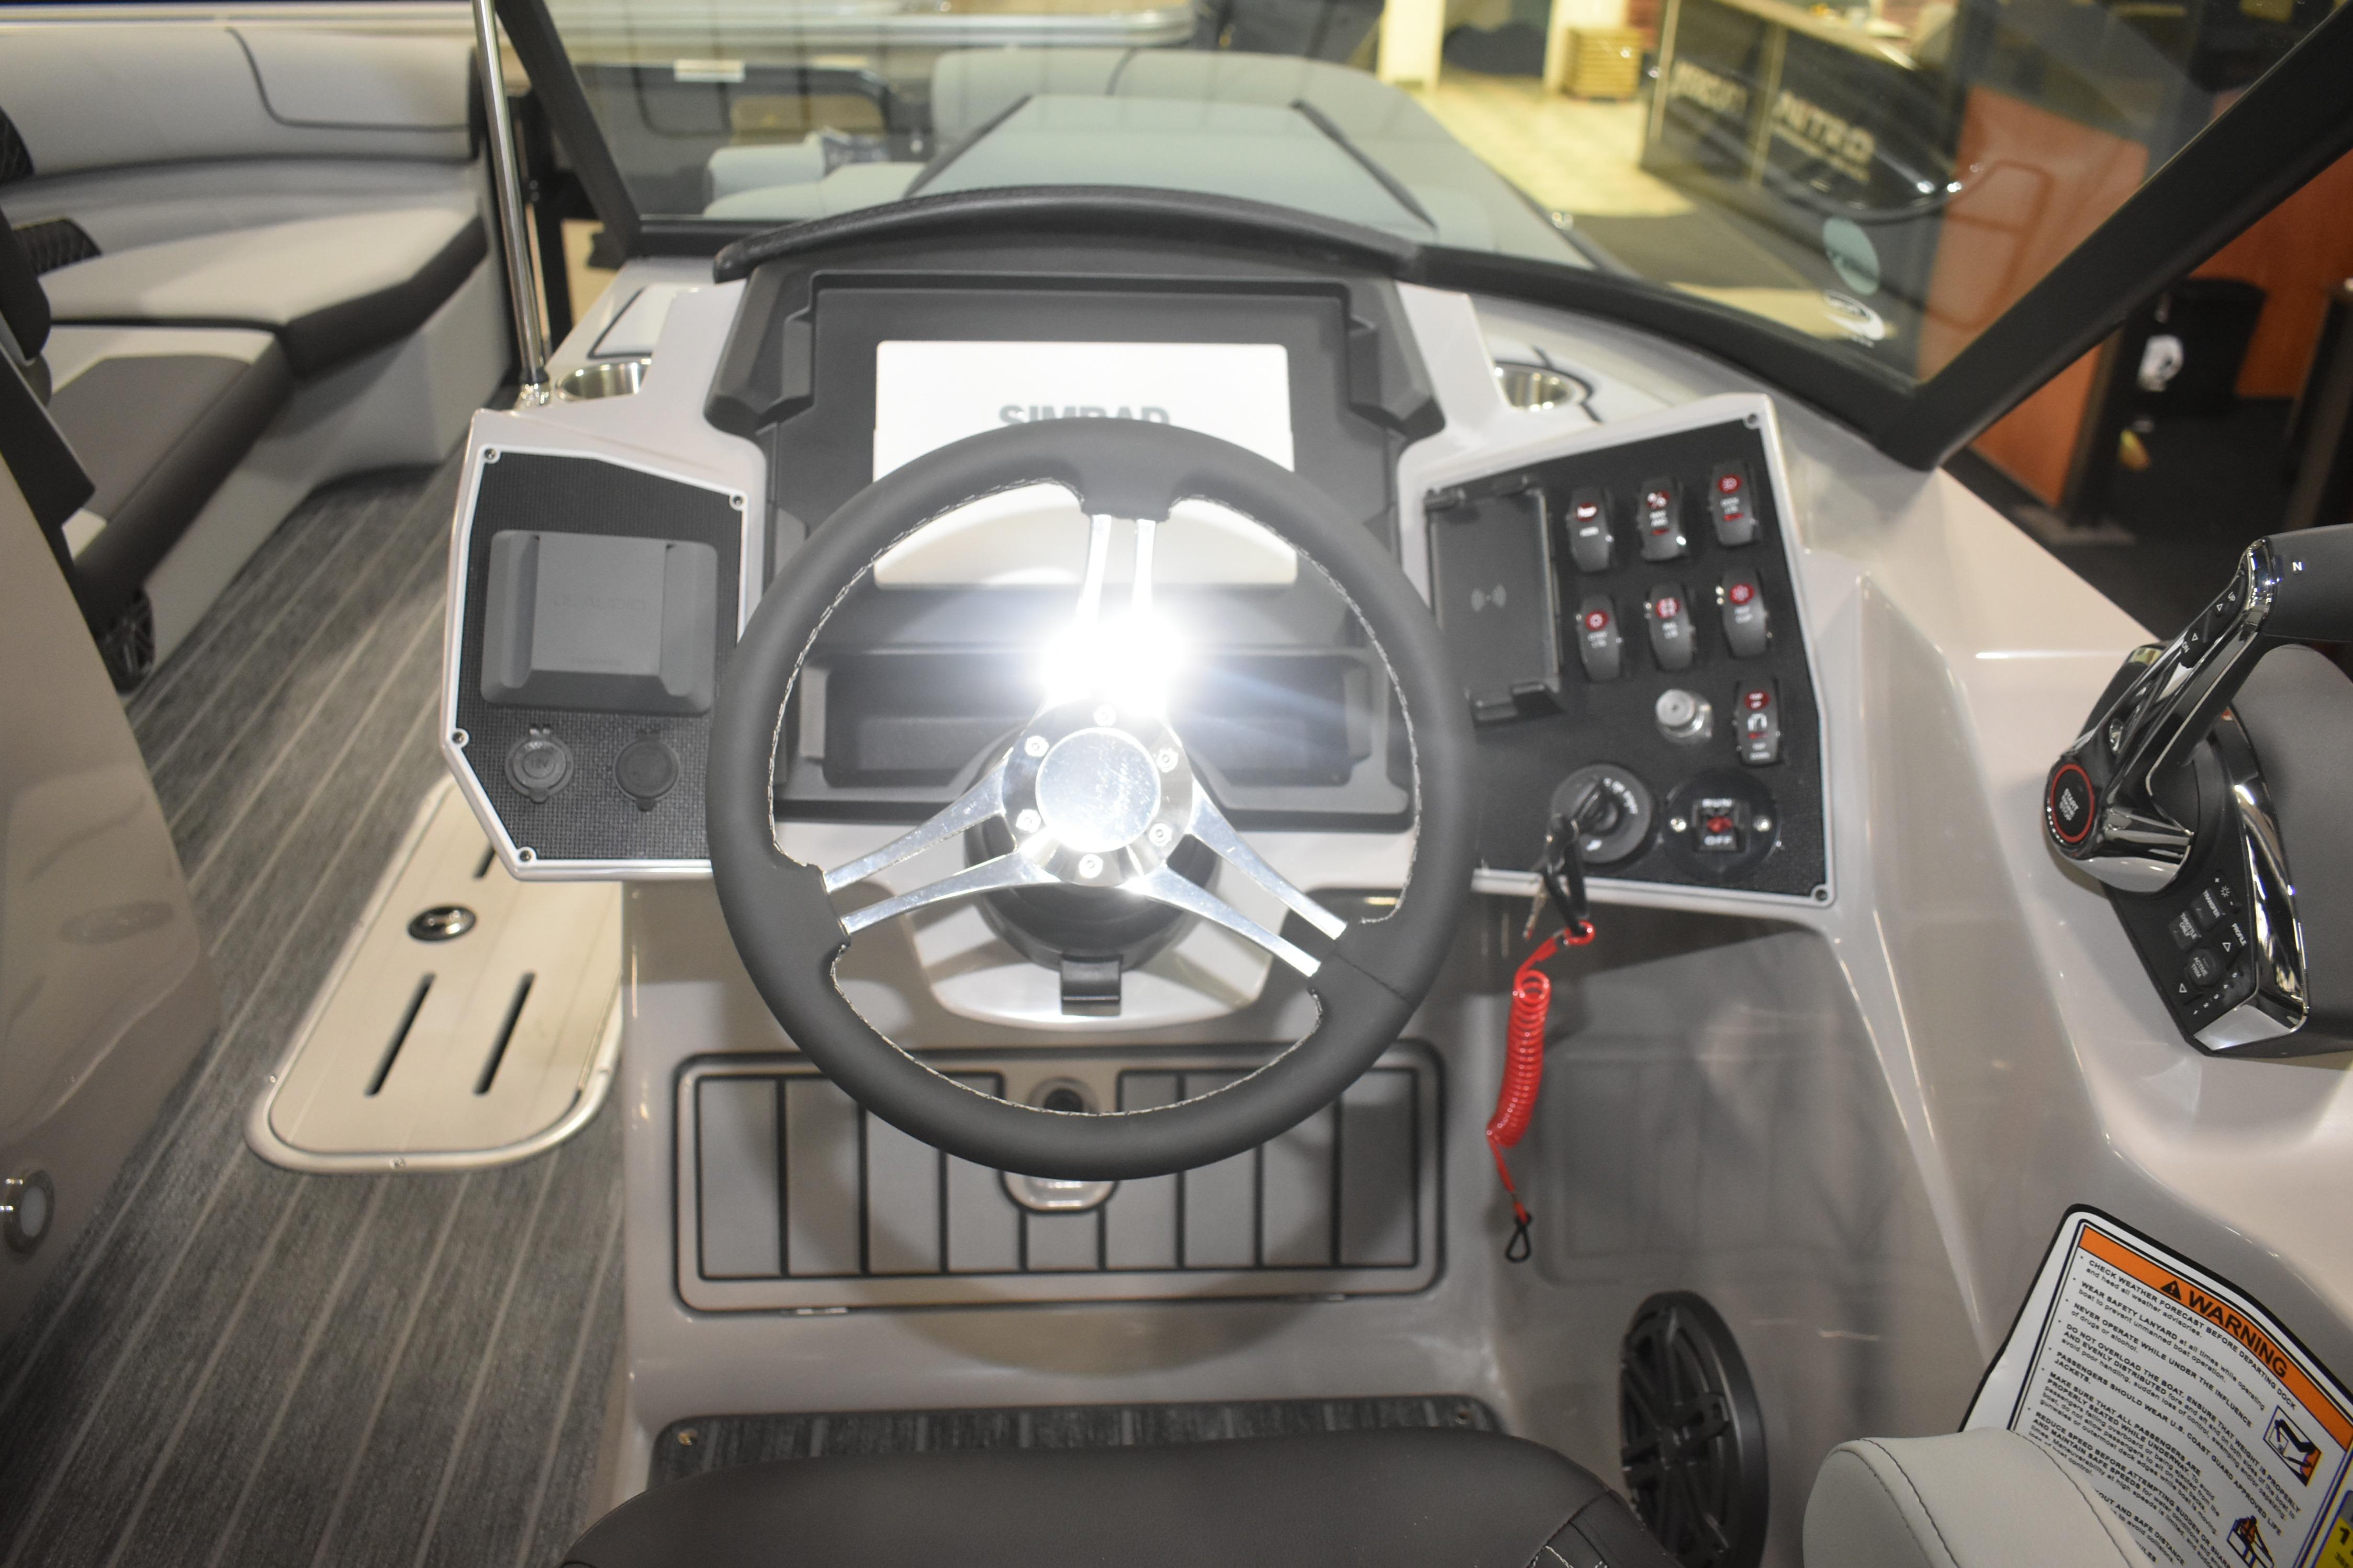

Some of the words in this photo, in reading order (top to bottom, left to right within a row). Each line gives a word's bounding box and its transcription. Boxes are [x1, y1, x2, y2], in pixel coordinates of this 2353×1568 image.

[2228, 592, 2235, 601] UP
[2293, 561, 2302, 571] N
[1704, 836, 1733, 845] OFF
[2179, 922, 2190, 937] ONLY
[2180, 912, 2197, 939] THROTTLE
[2203, 889, 2220, 918] TRANSFER
[2232, 923, 2247, 946] PROFILE
[2191, 963, 2201, 978] TRIM
[2194, 957, 2208, 977] ACTIVE
[2079, 1289, 2094, 1301] boat
[2104, 1305, 2132, 1323] prevent
[2134, 1319, 2172, 1346] unmanned
[2173, 1344, 2190, 1357] boat
[2192, 1356, 2225, 1382] operation.
[2080, 1314, 2100, 1330] drugs
[2111, 1334, 2138, 1353] alcohol.
[2086, 1268, 2099, 1278] and
[2102, 1276, 2119, 1289] heed
[2132, 1293, 2161, 1313] weather
[2162, 1312, 2202, 1337] advisories.
[2089, 1260, 2117, 1279] CHECK
[2119, 1277, 2157, 1302] WEATHER
[2159, 1299, 2204, 1328] FORECAST
[2206, 1326, 2240, 1352] BEFORE
[2239, 1351, 2276, 1389] DEPARTING
[2277, 1389, 2296, 1411] DOCK
[2189, 1290, 2287, 1378] WARNING
[2054, 1359, 2091, 1384] JACKETS.
[2074, 1303, 2100, 1322] NEVER
[2102, 1319, 2138, 1344] OPERATE
[2141, 1341, 2167, 1360] WHILE
[2169, 1358, 2197, 1379] UNDER
[2199, 1376, 2214, 1392] THE
[2215, 1389, 2252, 1428] INFLUENCE
[2082, 1281, 2105, 1299] WEAR
[2107, 1296, 2137, 1316] SAFETY
[2139, 1314, 2177, 1340] LANYARD
[2189, 1344, 2198, 1352] all
[2200, 1350, 2218, 1367] times
[2221, 1366, 2237, 1382] while
[2238, 1381, 2265, 1411] operating
[2045, 1386, 2083, 1413] passengers
[2085, 1411, 2107, 1427] falling
[2108, 1425, 2144, 1449] overboard
[2155, 1454, 2173, 1470] being
[2175, 1469, 2197, 1491] ejected
[2198, 1490, 2210, 1505] from
[2047, 1378, 2088, 1406] PROPERLY
[2089, 1404, 2119, 1426] SEATED
[2121, 1423, 2146, 1442] WHILE
[2147, 1440, 2190, 1475] UNDERWAY.
[2192, 1474, 2198, 1483] To
[2200, 1484, 2215, 1501] avoid
[2049, 1372, 2072, 1387] MAKE
[2074, 1386, 2095, 1402] SURE
[2097, 1400, 2116, 1415] THAT
[2117, 1414, 2132, 1426] ALL
[2134, 1423, 2185, 1461] PASSENGERS
[2186, 1461, 2201, 1476] ARE
[2057, 1351, 2108, 1385] PASSENGERS
[2110, 1384, 2142, 1406] SHOULD
[2145, 1405, 2168, 1422] WEAR
[2170, 1420, 2185, 1434] U.S.
[2187, 1432, 2211, 1456] COAST
[2211, 1455, 2233, 1481] GUARD
[2234, 1480, 2267, 1518] APPROVED
[2267, 1518, 2282, 1536] LIFE
[2061, 1339, 2080, 1352] avoid
[2082, 1351, 2098, 1362] poor
[2100, 1361, 2131, 1383] handling,
[2134, 1382, 2160, 1400] sudden
[2162, 1398, 2177, 1411] loss
[2187, 1415, 2210, 1438] control,
[2212, 1437, 2239, 1468] swamping
[2241, 1468, 2258, 1488] and/or
[2064, 1332, 2080, 1344] AND
[2082, 1341, 2112, 1361] EVENLY
[2114, 1360, 2166, 1395] DISTRIBUTED
[2168, 1393, 2182, 1405] fore
[2184, 1404, 2198, 1416] and
[2199, 1415, 2208, 1424] aft
[2209, 1424, 2221, 1436] and
[2222, 1436, 2228, 1445] on
[2230, 1443, 2242, 1460] both
[2243, 1459, 2257, 1477] sides
[2266, 1484, 2274, 1495] the
[2276, 1495, 2288, 1512] boat
[2066, 1324, 2078, 1334] DO
[2080, 1332, 2096, 1344] NOT
[2098, 1343, 2142, 1371] OVERLOAD
[2144, 1369, 2160, 1382] THE
[2161, 1380, 2184, 1398] BOAT.
[2187, 1396, 2216, 1422] ENSURE
[2218, 1420, 2234, 1439] THAT
[2235, 1439, 2259, 1466] WEIGHT
[2260, 1466, 2266, 1475] IS
[2267, 1474, 2300, 1513] PROPERLY
[2072, 1411, 2083, 1420] not
[2085, 1418, 2102, 1431] allow
[2104, 1431, 2144, 1458] passengers
[2165, 1470, 2173, 1479] on
[2033, 1419, 2049, 1431] AND
[2051, 1429, 2086, 1454] MAINTAIN
[2088, 1453, 2108, 1469] SAFE
[2110, 1467, 2141, 1490] SPEEDS
[2142, 1487, 2152, 1497] for
[2154, 1496, 2171, 1512] water
[2036, 1412, 2066, 1434] REDUCE
[2068, 1432, 2093, 1450] SPEED
[2095, 1449, 2126, 1471] BEFORE
[2127, 1471, 2175, 1507] ATTEMPTING
[2176, 1506, 2201, 1535] SUDDEN
[2201, 1534, 2210, 1547] OR
[2053, 1439, 2105, 1476] Maneuverability
[2116, 1479, 2131, 1492] high
[2133, 1491, 2157, 1509] speeds
[2073, 1420, 2081, 1428] or
[2082, 1426, 2117, 1450] outermost
[2119, 1448, 2135, 1461] deck
[2137, 1460, 2158, 1476] edges
[2160, 1474, 2177, 1490] while
[2115, 1504, 2132, 1516] AND
[2134, 1516, 2154, 1532] SAFE
[2155, 1532, 2185, 1566] DISTANCE
[2127, 1521, 2145, 1535] avoid
